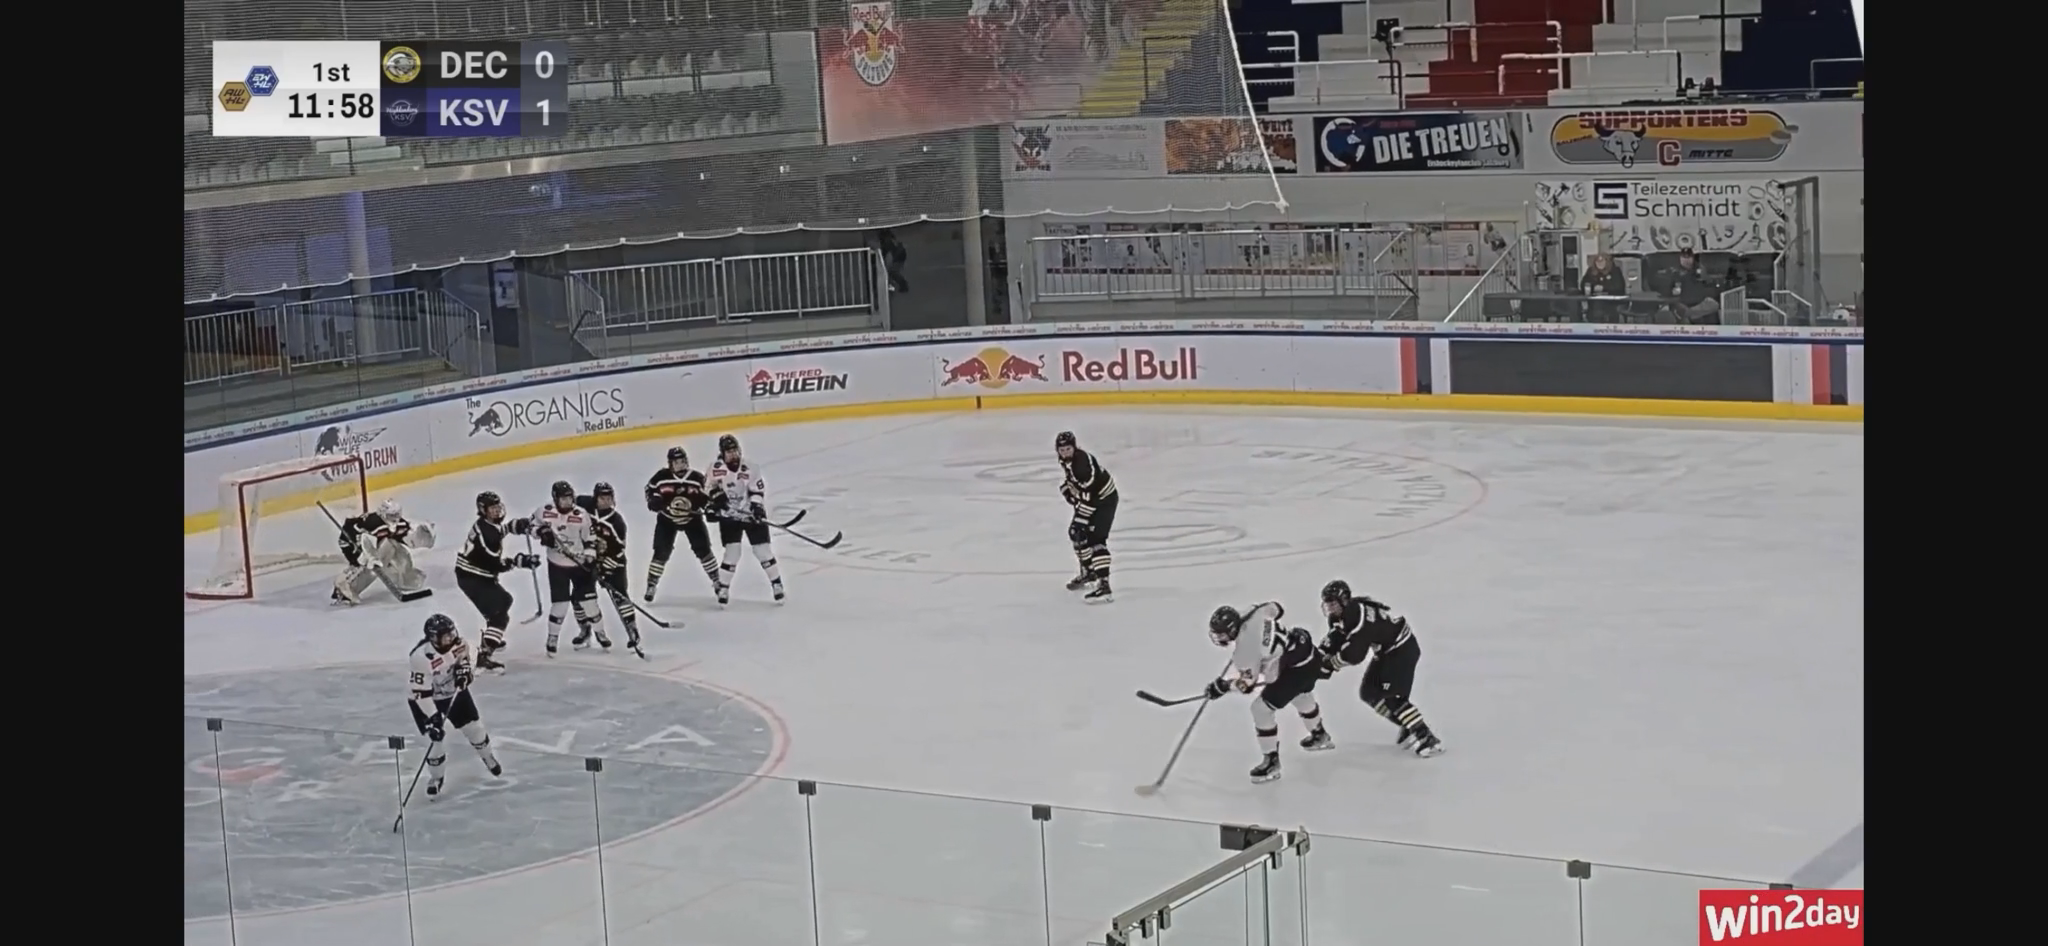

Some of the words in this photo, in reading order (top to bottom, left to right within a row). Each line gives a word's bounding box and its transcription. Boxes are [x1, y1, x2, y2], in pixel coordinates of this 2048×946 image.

[1579, 108, 1748, 129] SUPPORTERS
[1372, 132, 1414, 164] DIE
[1415, 117, 1508, 157] TREUEN
[1658, 140, 1681, 166] C
[1631, 182, 1742, 196] Teilezentrum
[1634, 198, 1741, 217] Schmidt
[775, 371, 798, 380] THE
[798, 368, 823, 377] RED
[1062, 347, 1129, 382] Red
[1134, 347, 1198, 381] Bull
[466, 398, 481, 409] The
[584, 421, 604, 432] Red
[604, 416, 625, 429] Bull
